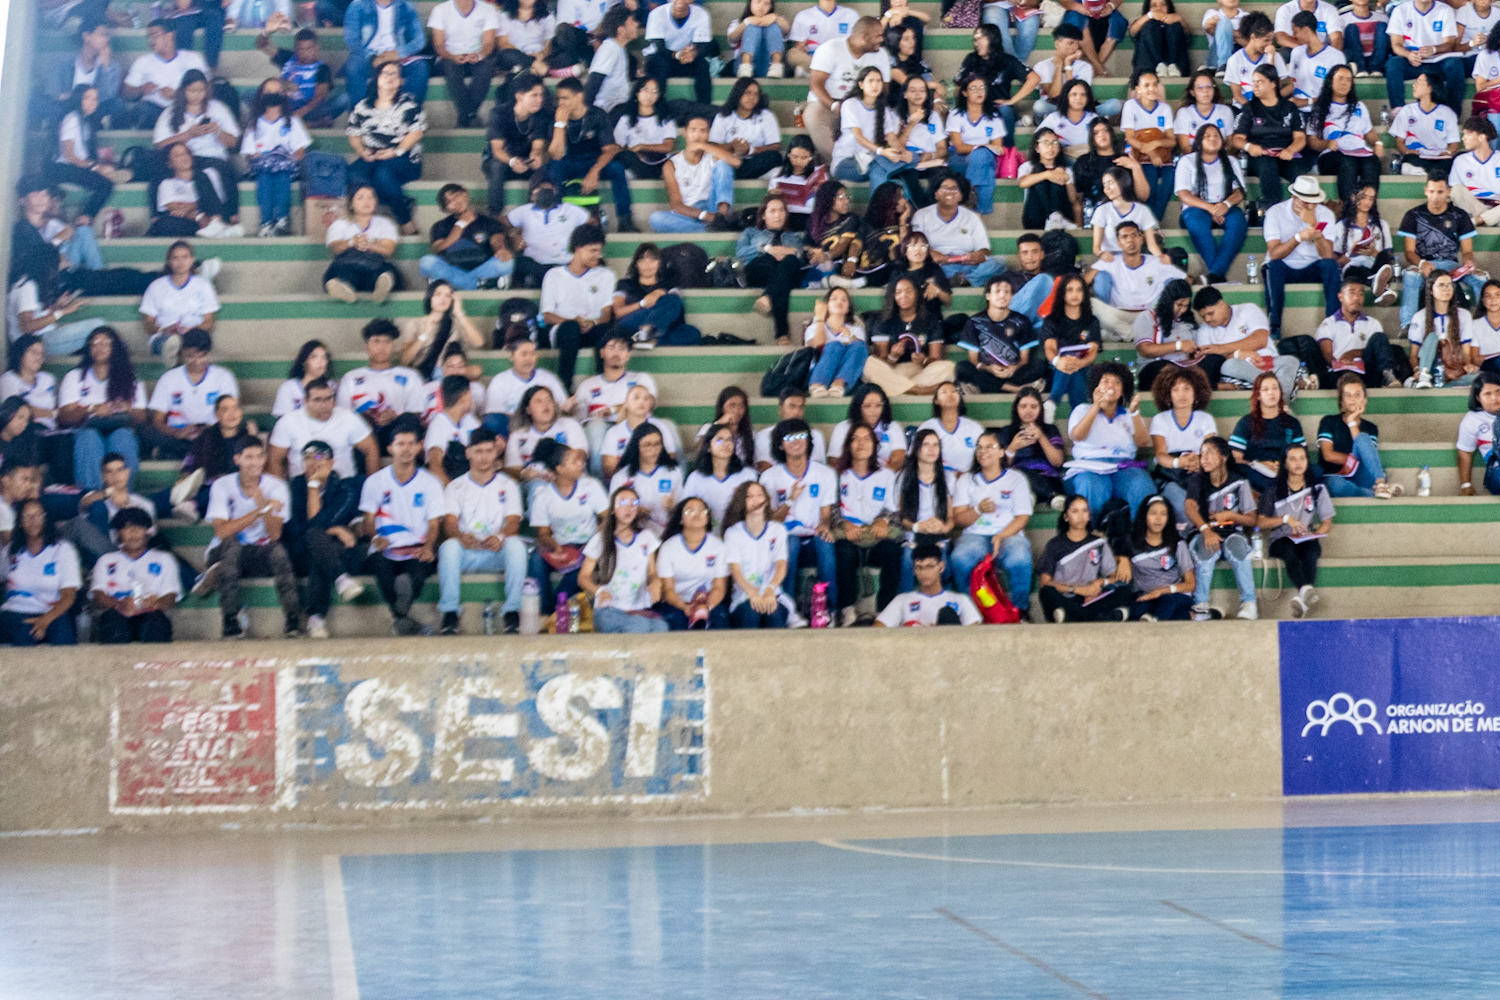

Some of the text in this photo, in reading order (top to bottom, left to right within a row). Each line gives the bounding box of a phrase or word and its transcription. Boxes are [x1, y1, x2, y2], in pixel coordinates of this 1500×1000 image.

[1386, 700, 1485, 717] ORGANIZAÇÃO
[335, 672, 666, 788] SESI
[1386, 717, 1449, 734] ARNON
[1452, 717, 1474, 732] DE
